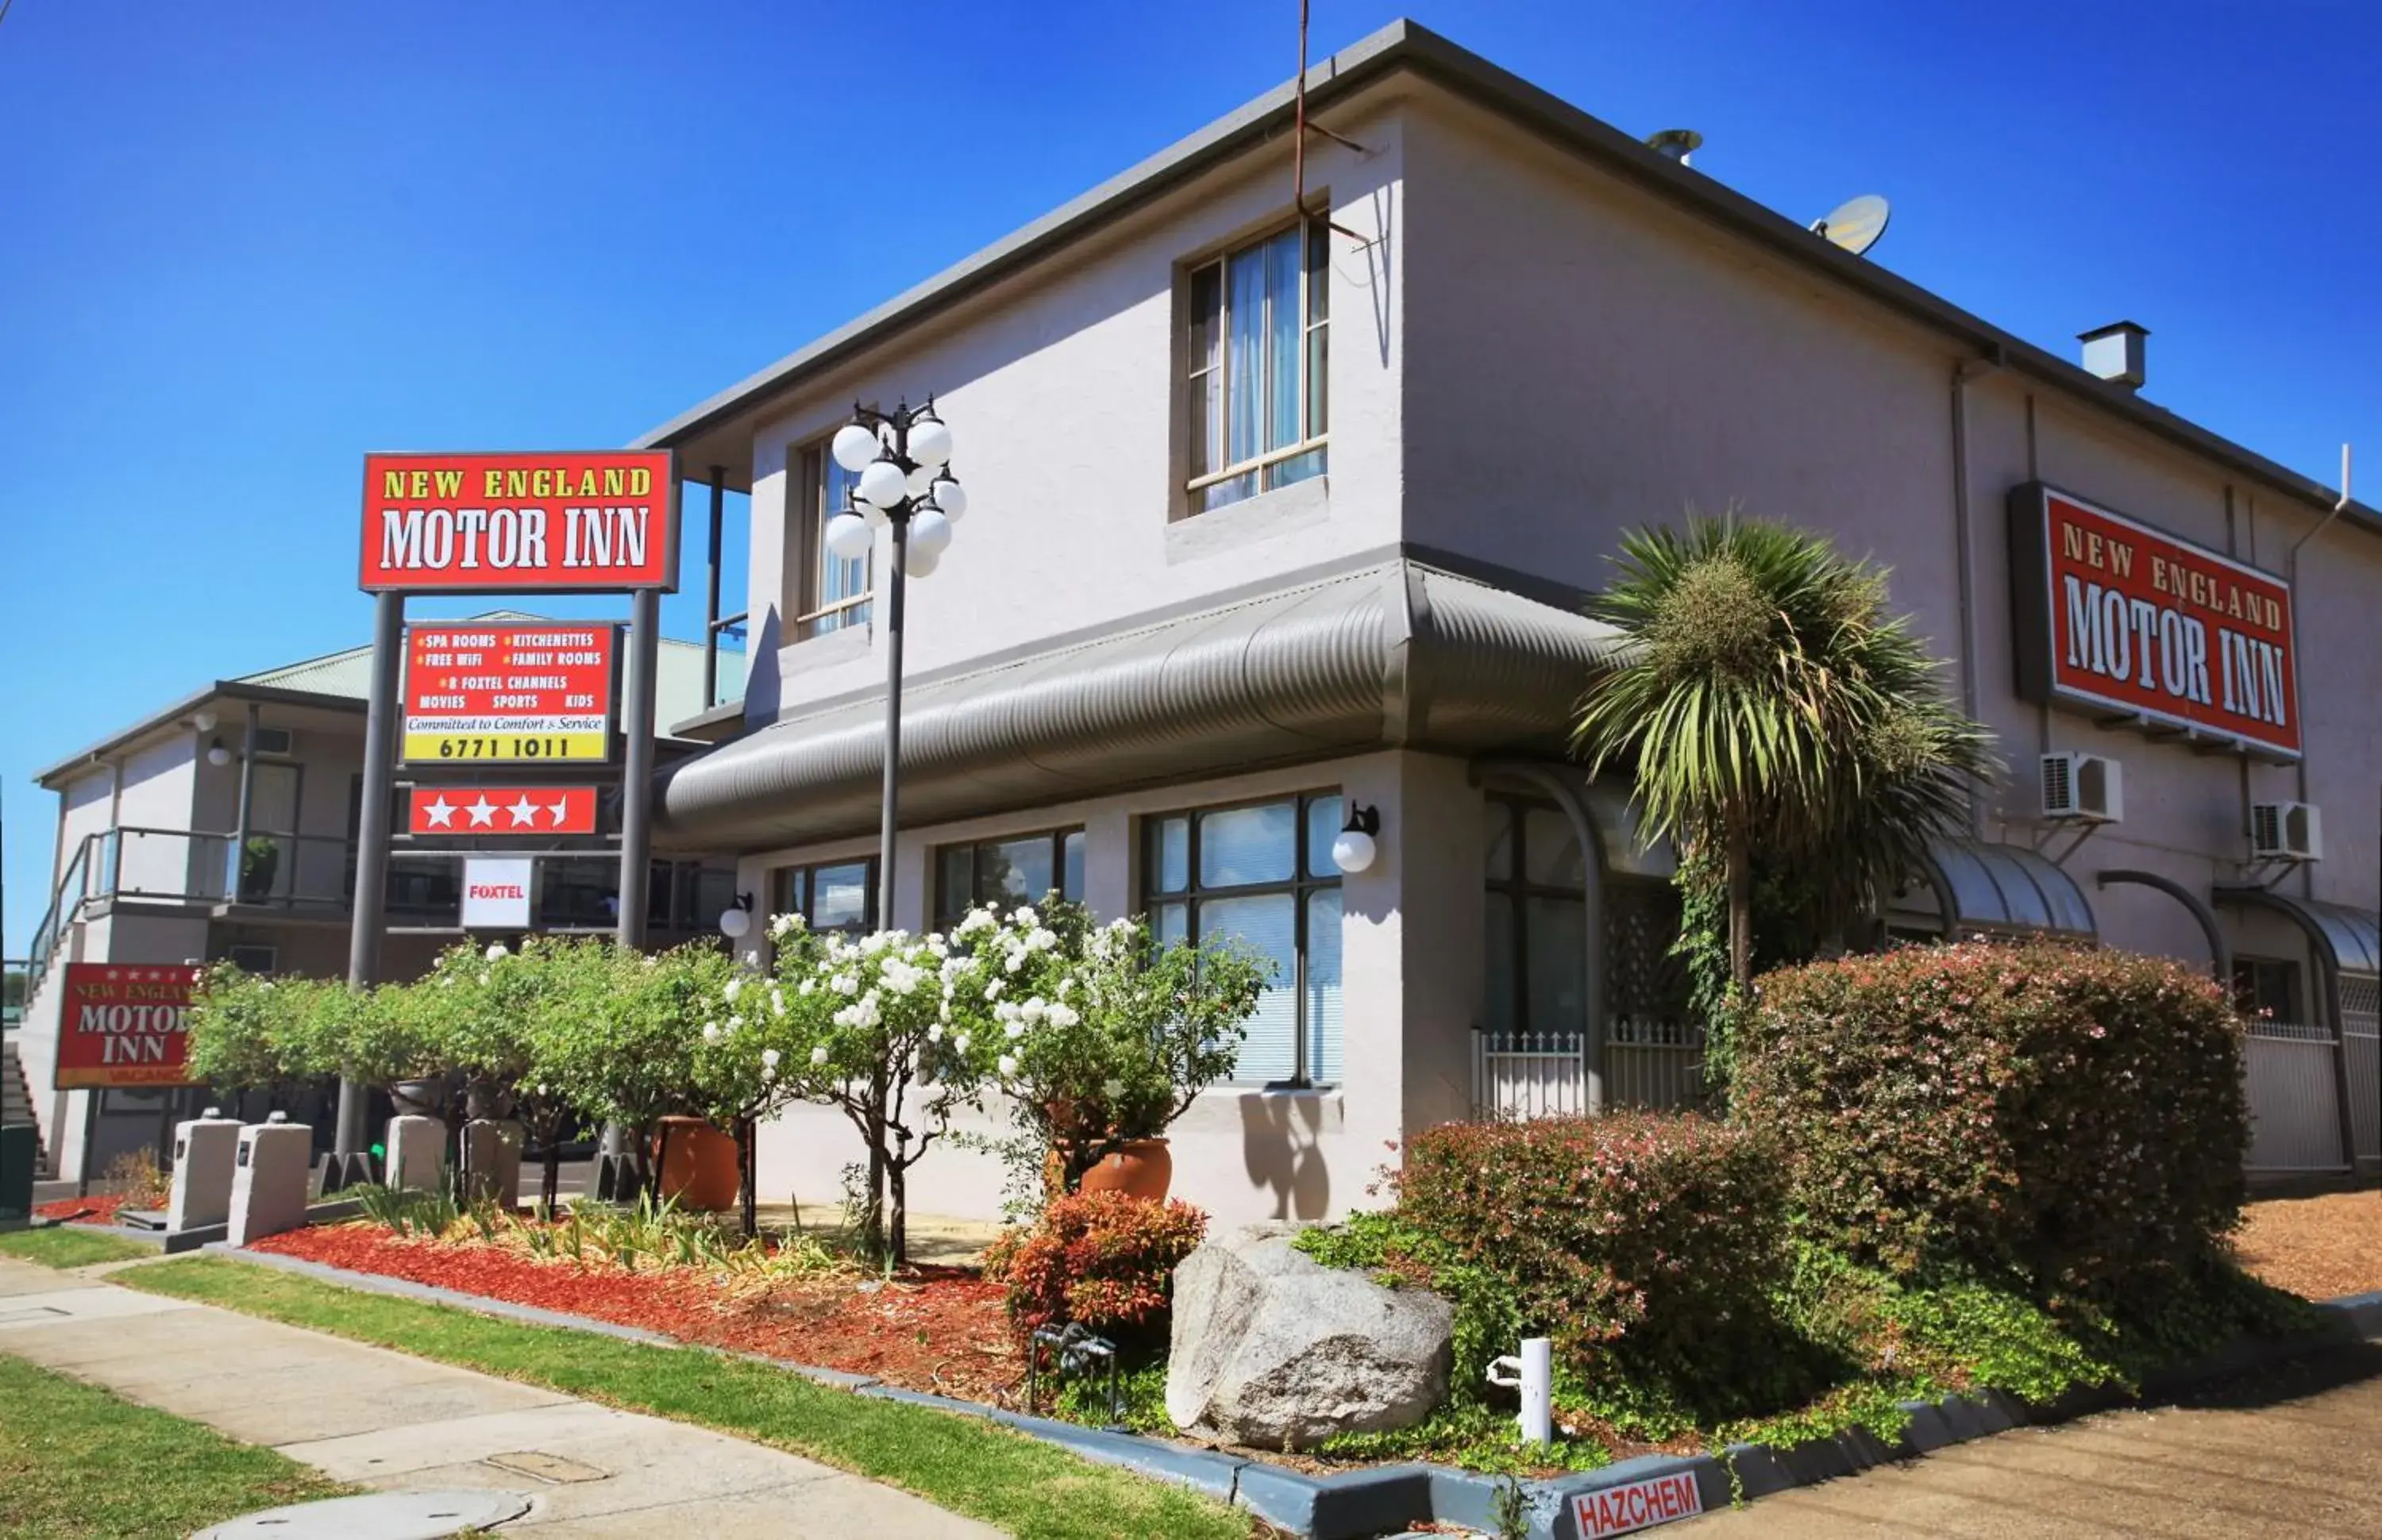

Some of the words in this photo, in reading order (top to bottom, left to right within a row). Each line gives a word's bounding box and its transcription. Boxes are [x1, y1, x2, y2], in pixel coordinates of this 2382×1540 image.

[384, 471, 464, 499] NEW
[484, 468, 651, 499] ENGLAND
[380, 508, 547, 569] MOTOR
[562, 507, 649, 567] INN
[2062, 521, 2133, 579] NEW
[2150, 555, 2282, 632] ENGLAND
[426, 634, 448, 648] SPA
[452, 634, 496, 648] ROOMS
[512, 633, 594, 647] KITCHENETTES
[2064, 575, 2212, 706] MOTOR
[2219, 628, 2286, 726] INN
[425, 653, 453, 666] FREE
[512, 653, 553, 665] FAMILY
[557, 652, 601, 665] ROOMS
[461, 676, 503, 689] FOXTEL
[507, 676, 568, 689] CHANNELS
[419, 695, 466, 709] MOVIES
[492, 695, 538, 709] SPORTS
[565, 695, 594, 708] KIDS
[408, 718, 476, 730] Committed
[479, 718, 491, 730] to
[494, 717, 544, 730] Comfort
[557, 716, 601, 730] Service
[440, 738, 498, 757] 6771
[514, 738, 568, 757] 1011
[469, 885, 524, 899] FOXTEL
[75, 984, 115, 999] NEW
[125, 984, 191, 999] ENGLAN
[102, 1035, 166, 1064] INN
[1578, 1475, 1697, 1537] HAZCHEM
